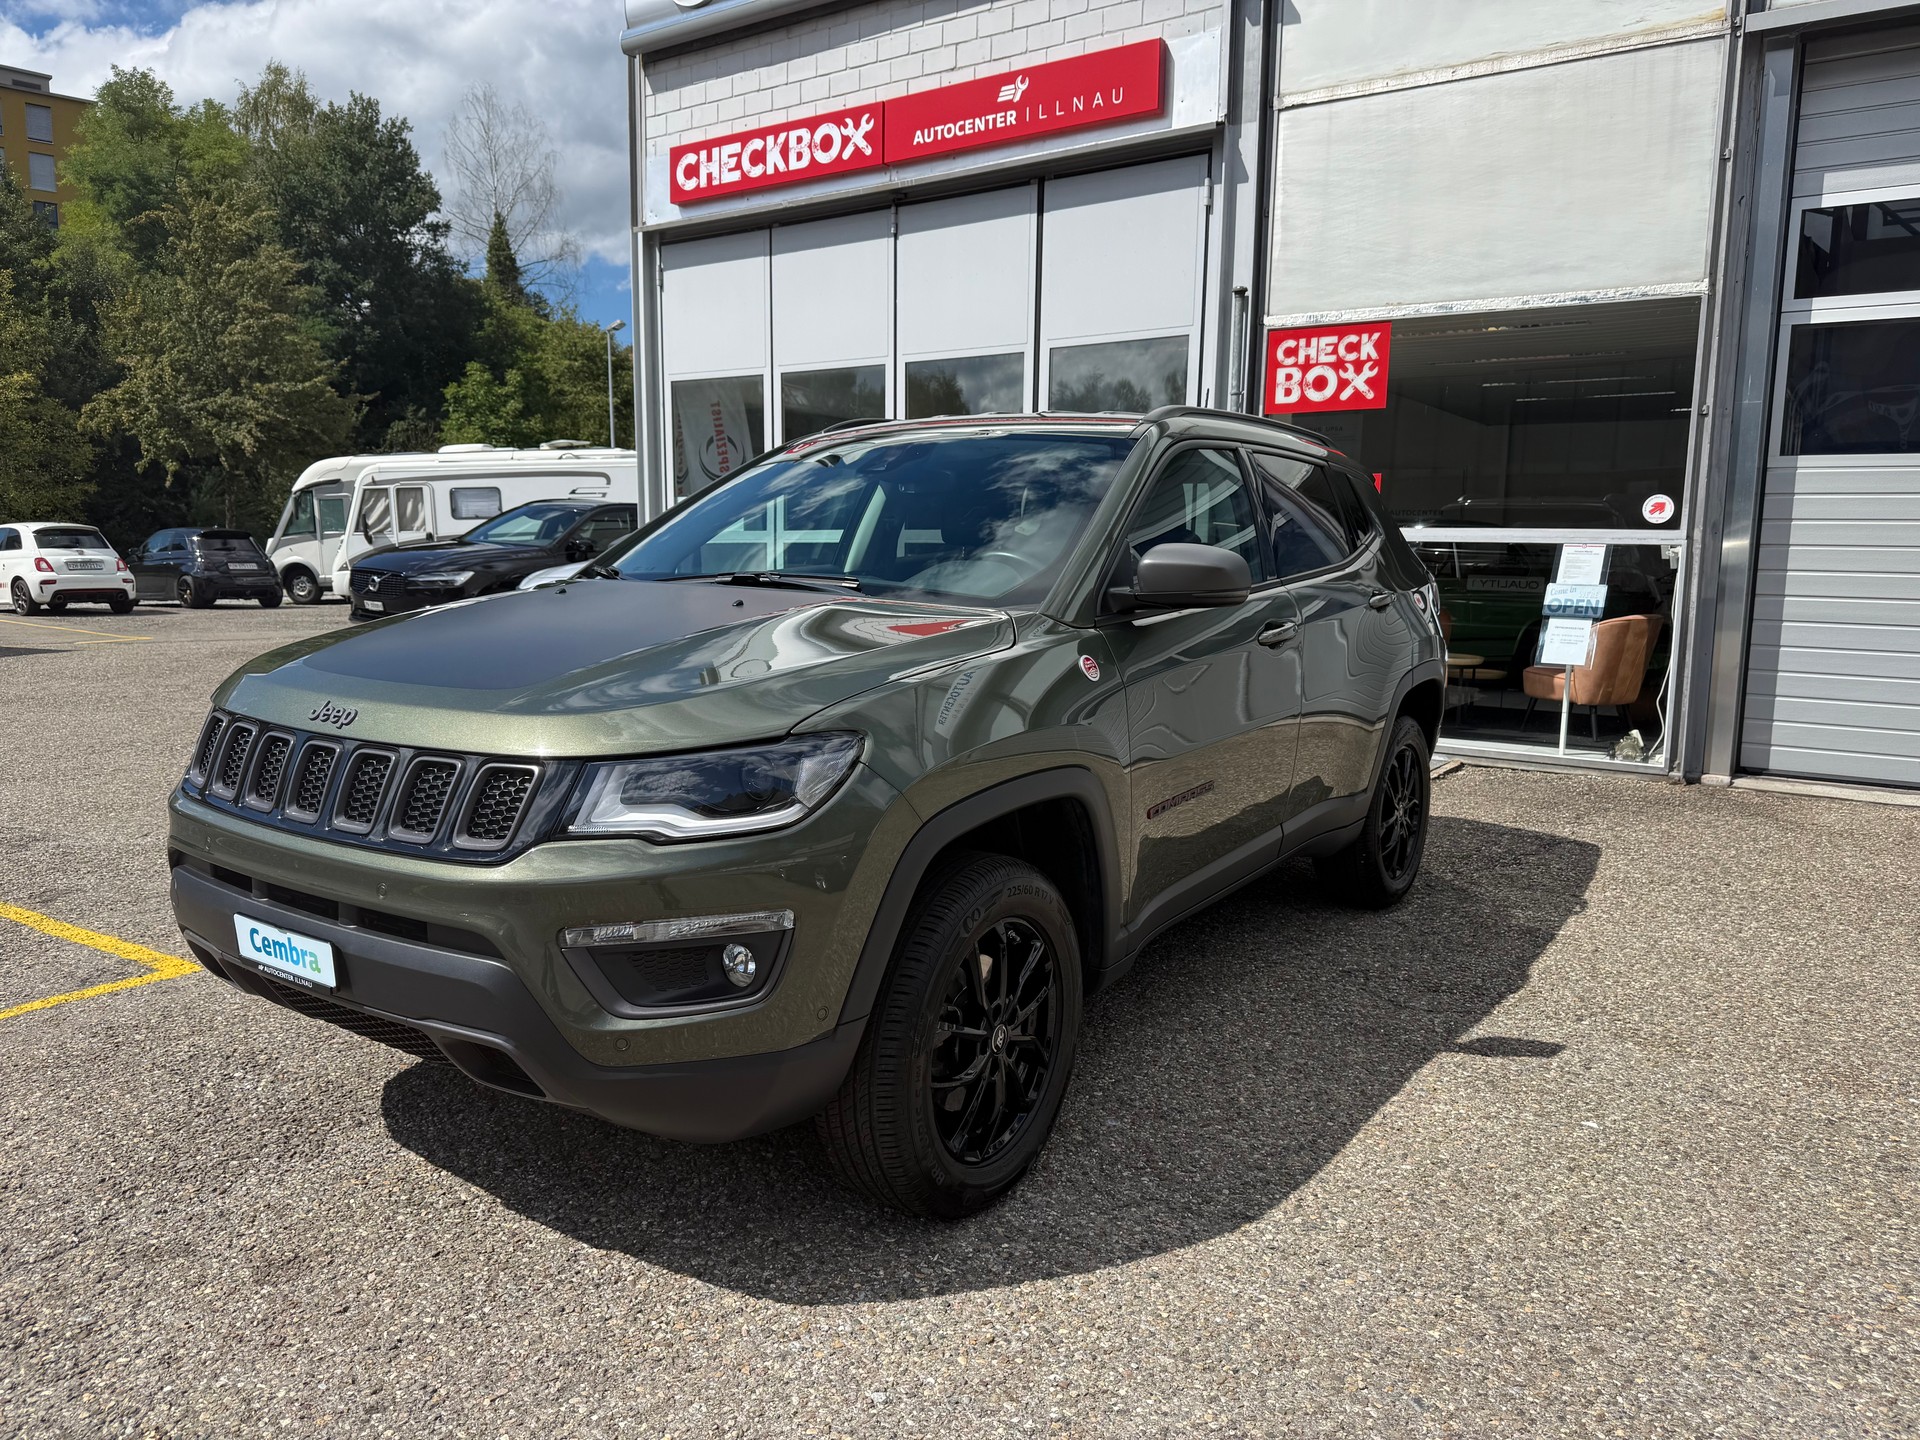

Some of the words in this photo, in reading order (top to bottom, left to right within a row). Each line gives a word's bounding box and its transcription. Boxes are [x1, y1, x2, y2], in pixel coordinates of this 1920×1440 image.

[912, 110, 1017, 145] AUTOCENTER
[1024, 87, 1125, 123] ILLNAU
[676, 113, 875, 192] CHECKBOX
[1276, 332, 1381, 365] CHECK
[1274, 361, 1379, 405] BOX
[1546, 597, 1600, 615] OPEN
[308, 700, 358, 730] Jeep
[1007, 884, 1033, 898] 225/60
[1034, 886, 1040, 897] R
[1041, 889, 1049, 900] 17
[249, 927, 321, 974] Cembra
[264, 966, 294, 982] AUTOCENTER
[294, 976, 313, 988] ILLNAU
